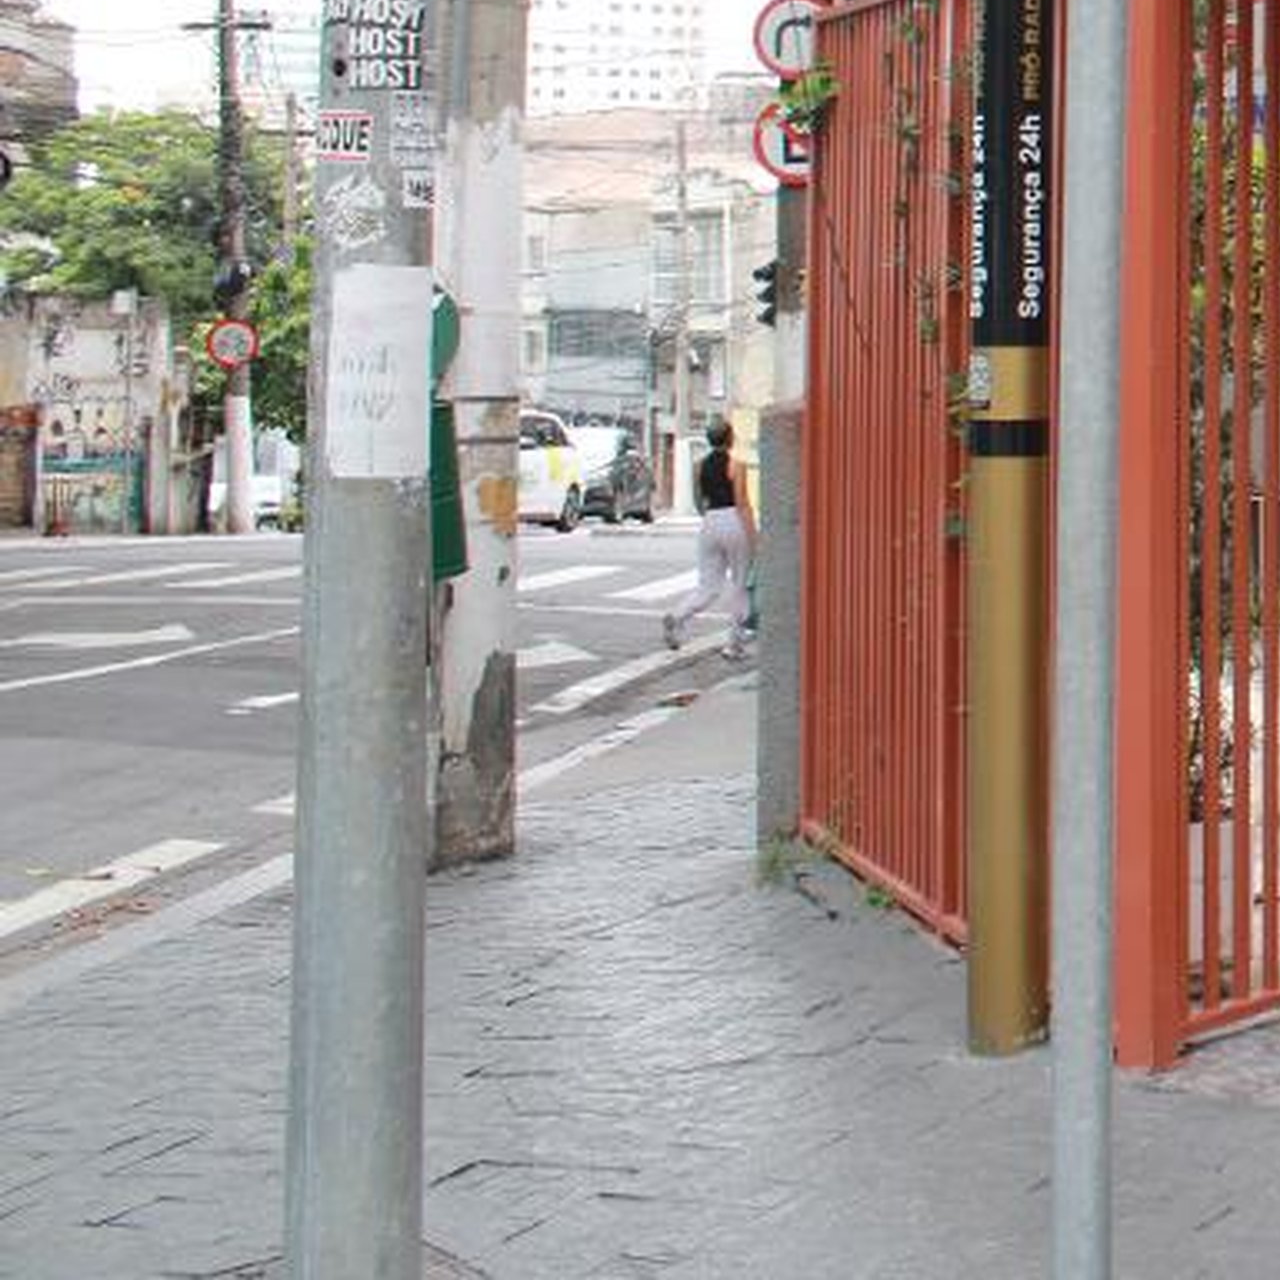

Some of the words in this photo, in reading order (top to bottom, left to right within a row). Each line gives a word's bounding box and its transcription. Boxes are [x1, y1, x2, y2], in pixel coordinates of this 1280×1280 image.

[348, 27, 421, 56] HOST
[348, 59, 421, 88] HOST
[1019, 114, 1042, 164] 24h
[1018, 171, 1045, 319] Segurança
